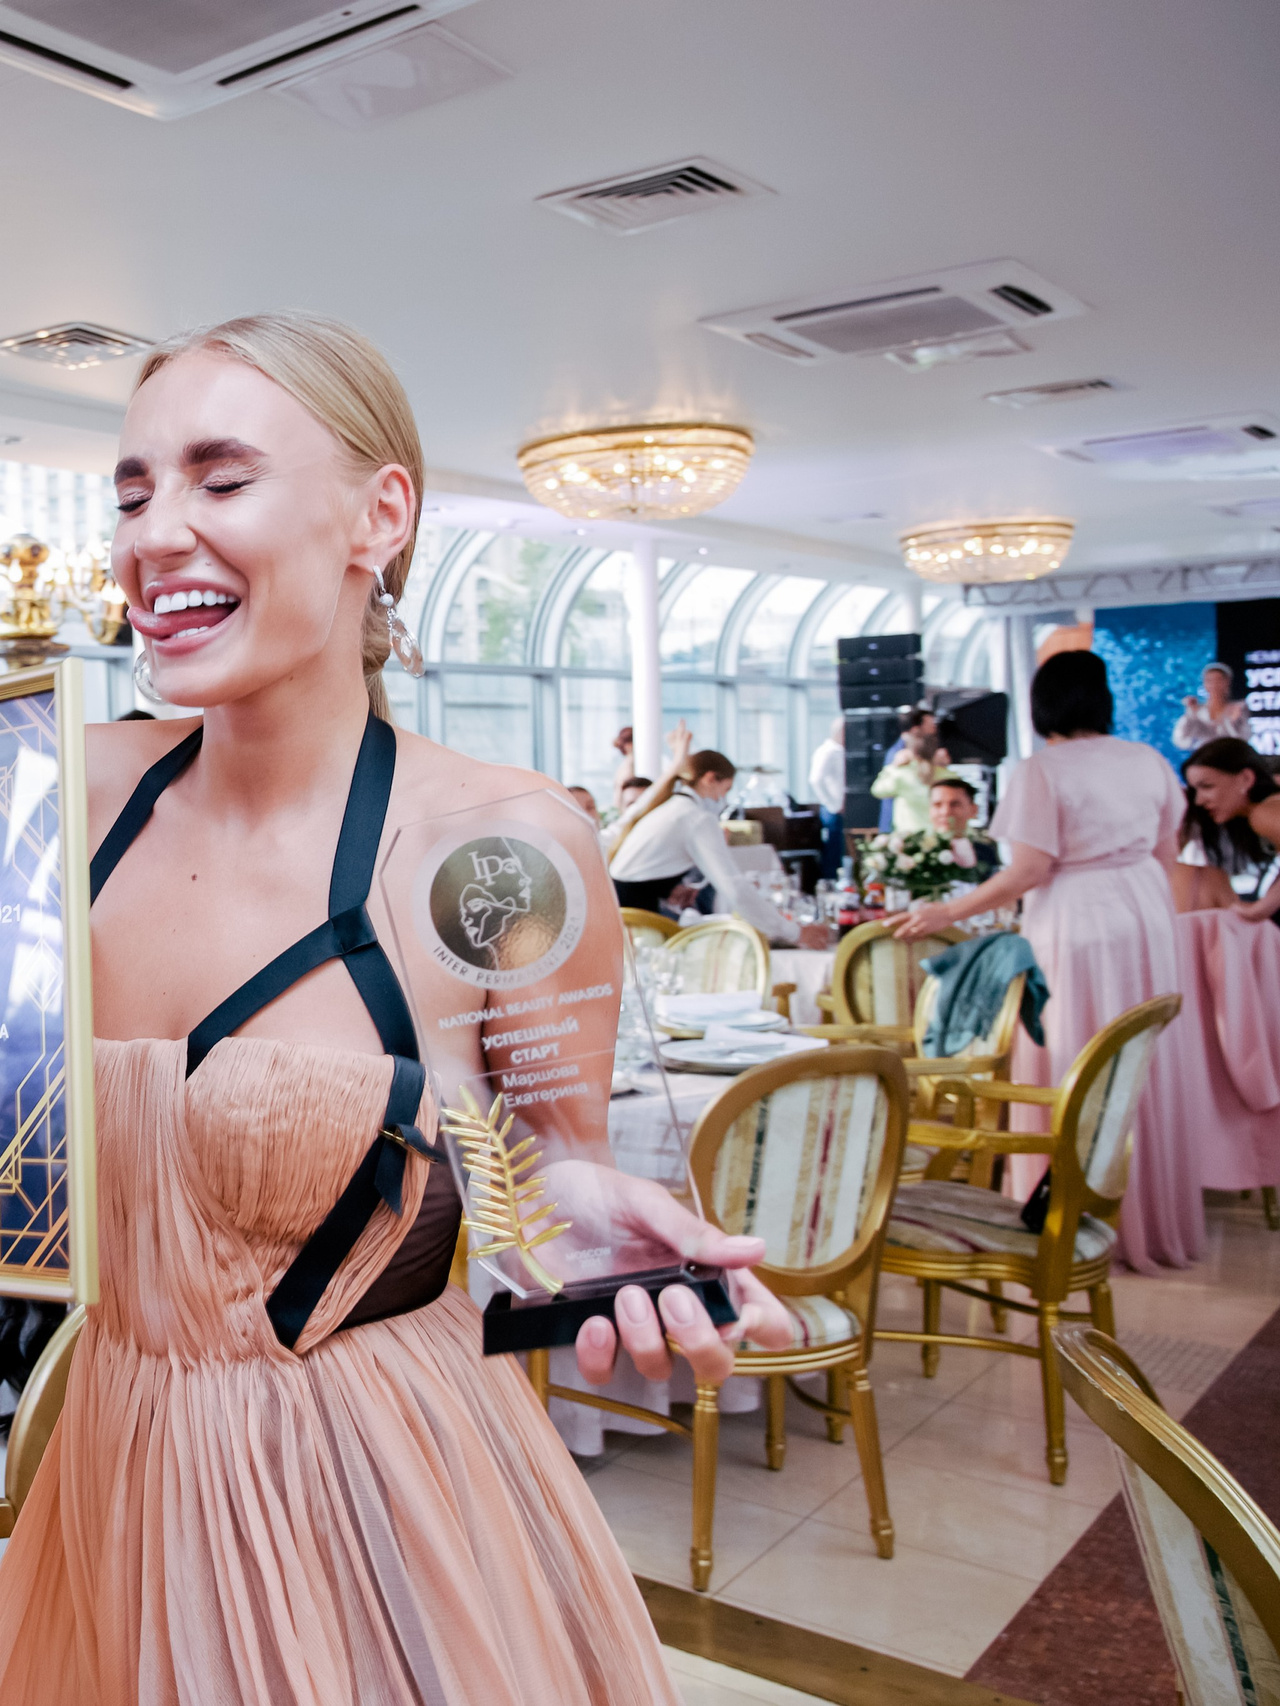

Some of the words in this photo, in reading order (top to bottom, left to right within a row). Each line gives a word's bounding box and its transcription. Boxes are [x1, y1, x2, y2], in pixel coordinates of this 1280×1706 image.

[433, 946, 469, 976] INTER
[438, 1008, 505, 1029] NATIONAL
[506, 996, 554, 1016] BEAUTY
[558, 983, 614, 1005] AWARDS
[481, 1016, 580, 1050] УСПЕШНЫЙ
[510, 1042, 560, 1064] СТАРТ
[502, 1064, 580, 1089] Маршова
[503, 1082, 589, 1108] Екатерина
